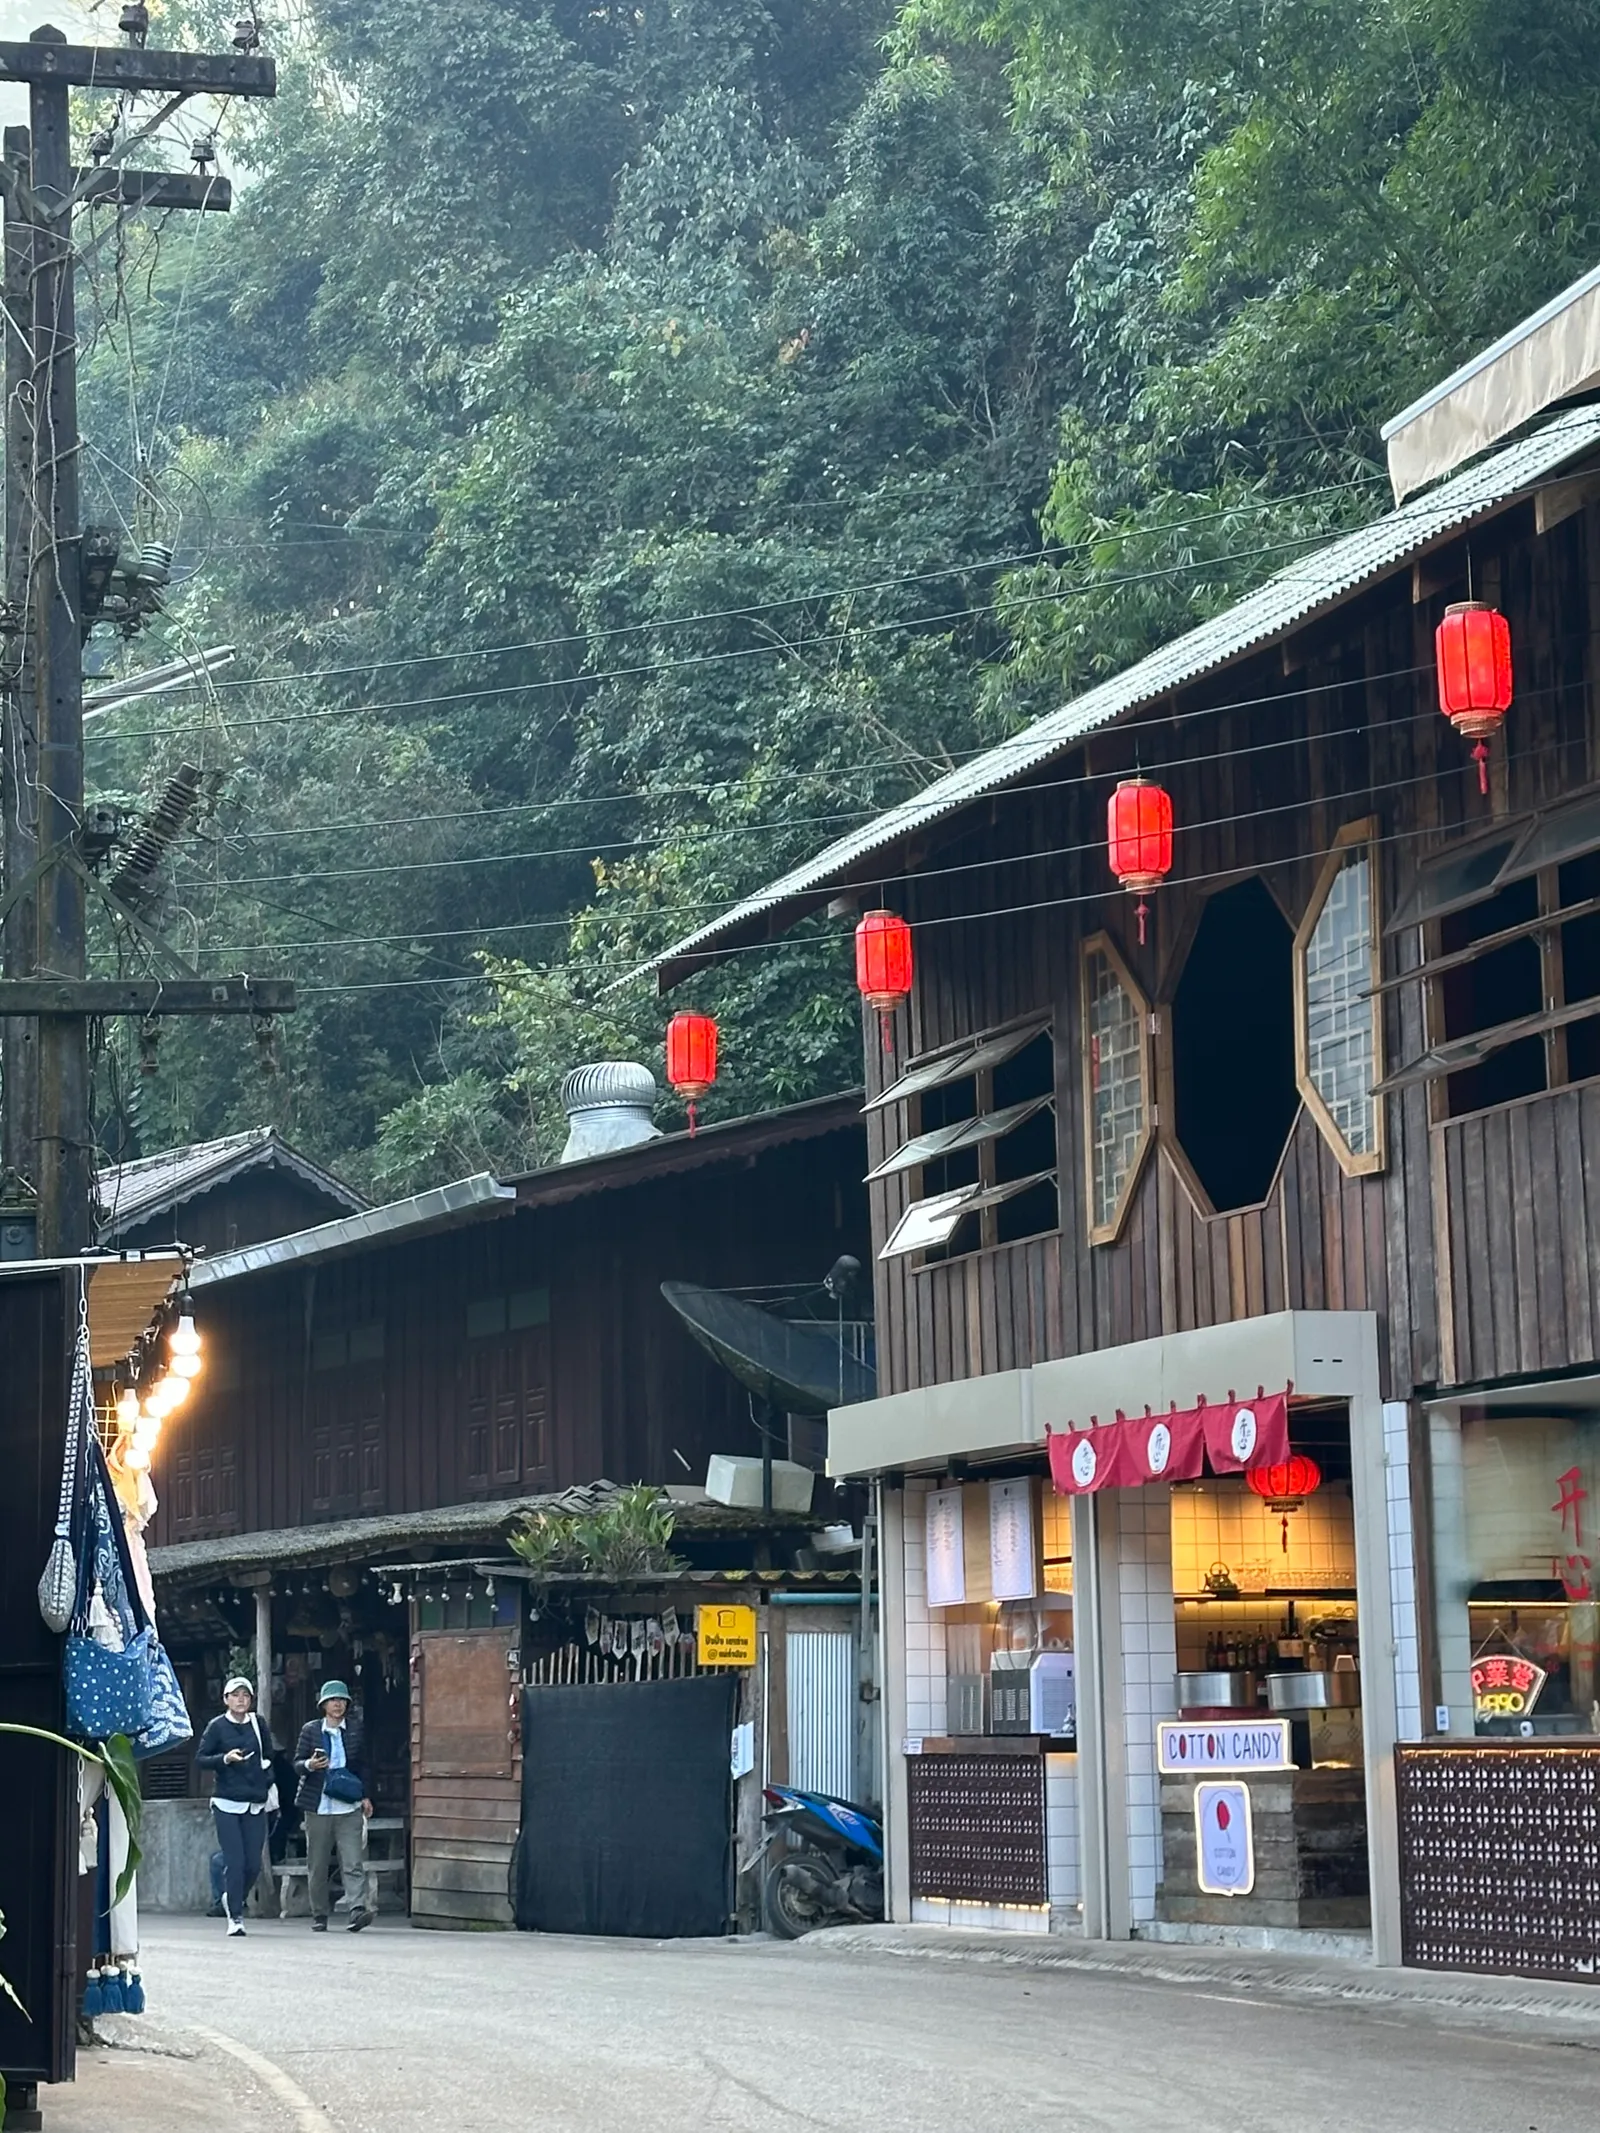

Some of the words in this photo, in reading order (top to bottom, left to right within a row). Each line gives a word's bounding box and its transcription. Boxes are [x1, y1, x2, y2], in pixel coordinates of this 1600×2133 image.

[1551, 1465, 1593, 1600] 开心
[1169, 1733, 1226, 1760] COTTON
[1232, 1731, 1282, 1760] CANDY
